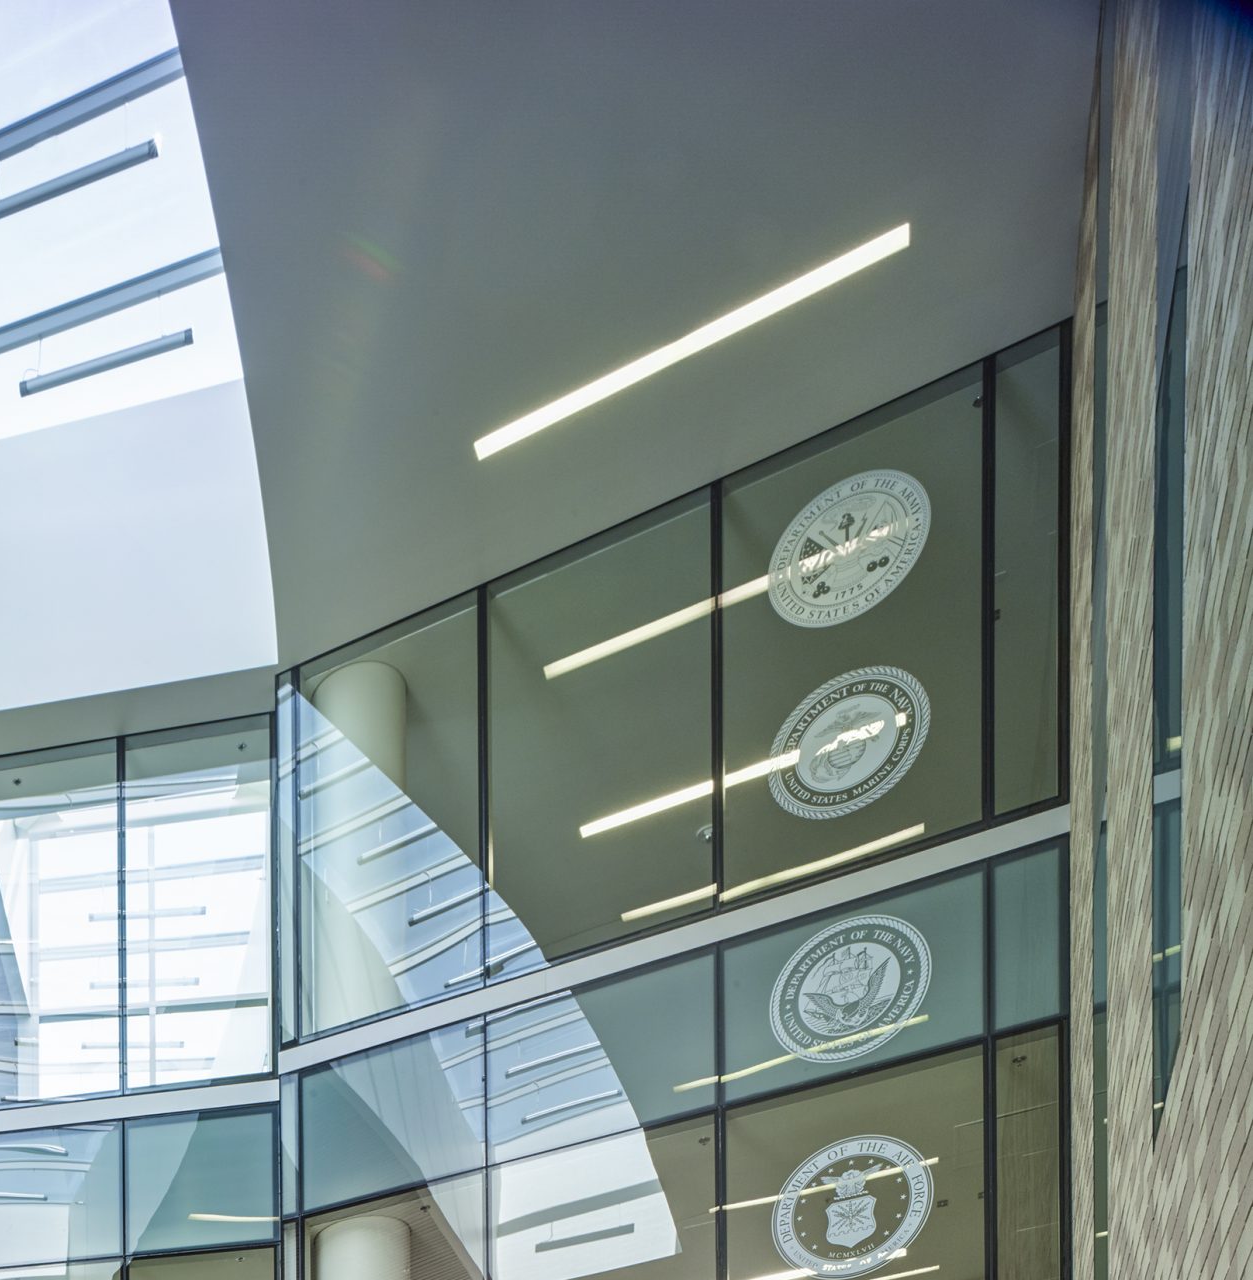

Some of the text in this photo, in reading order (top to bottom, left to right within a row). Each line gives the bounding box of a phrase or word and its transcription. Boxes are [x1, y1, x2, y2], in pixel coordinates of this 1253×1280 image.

[777, 478, 922, 571] DEPARTMENT OF THE ARMY
[777, 523, 922, 620] UNITED STATES OF AMERICA
[835, 584, 863, 600] 1775
[785, 682, 913, 754] EPARTMENT OF THE NAVY
[784, 727, 912, 805] UNITED STATES MARINE CORPS
[785, 929, 915, 1000] DEPARTMENT OF THE NAVY
[784, 1012, 812, 1048] UNITED
[779, 1160, 820, 1244] DEPARTMENT
[827, 1147, 847, 1161] OF
[857, 1142, 889, 1154] THE
[911, 1174, 925, 1218] FORCE
[793, 1250, 819, 1269] UNITED
[827, 1243, 875, 1259] MCMXLVII
